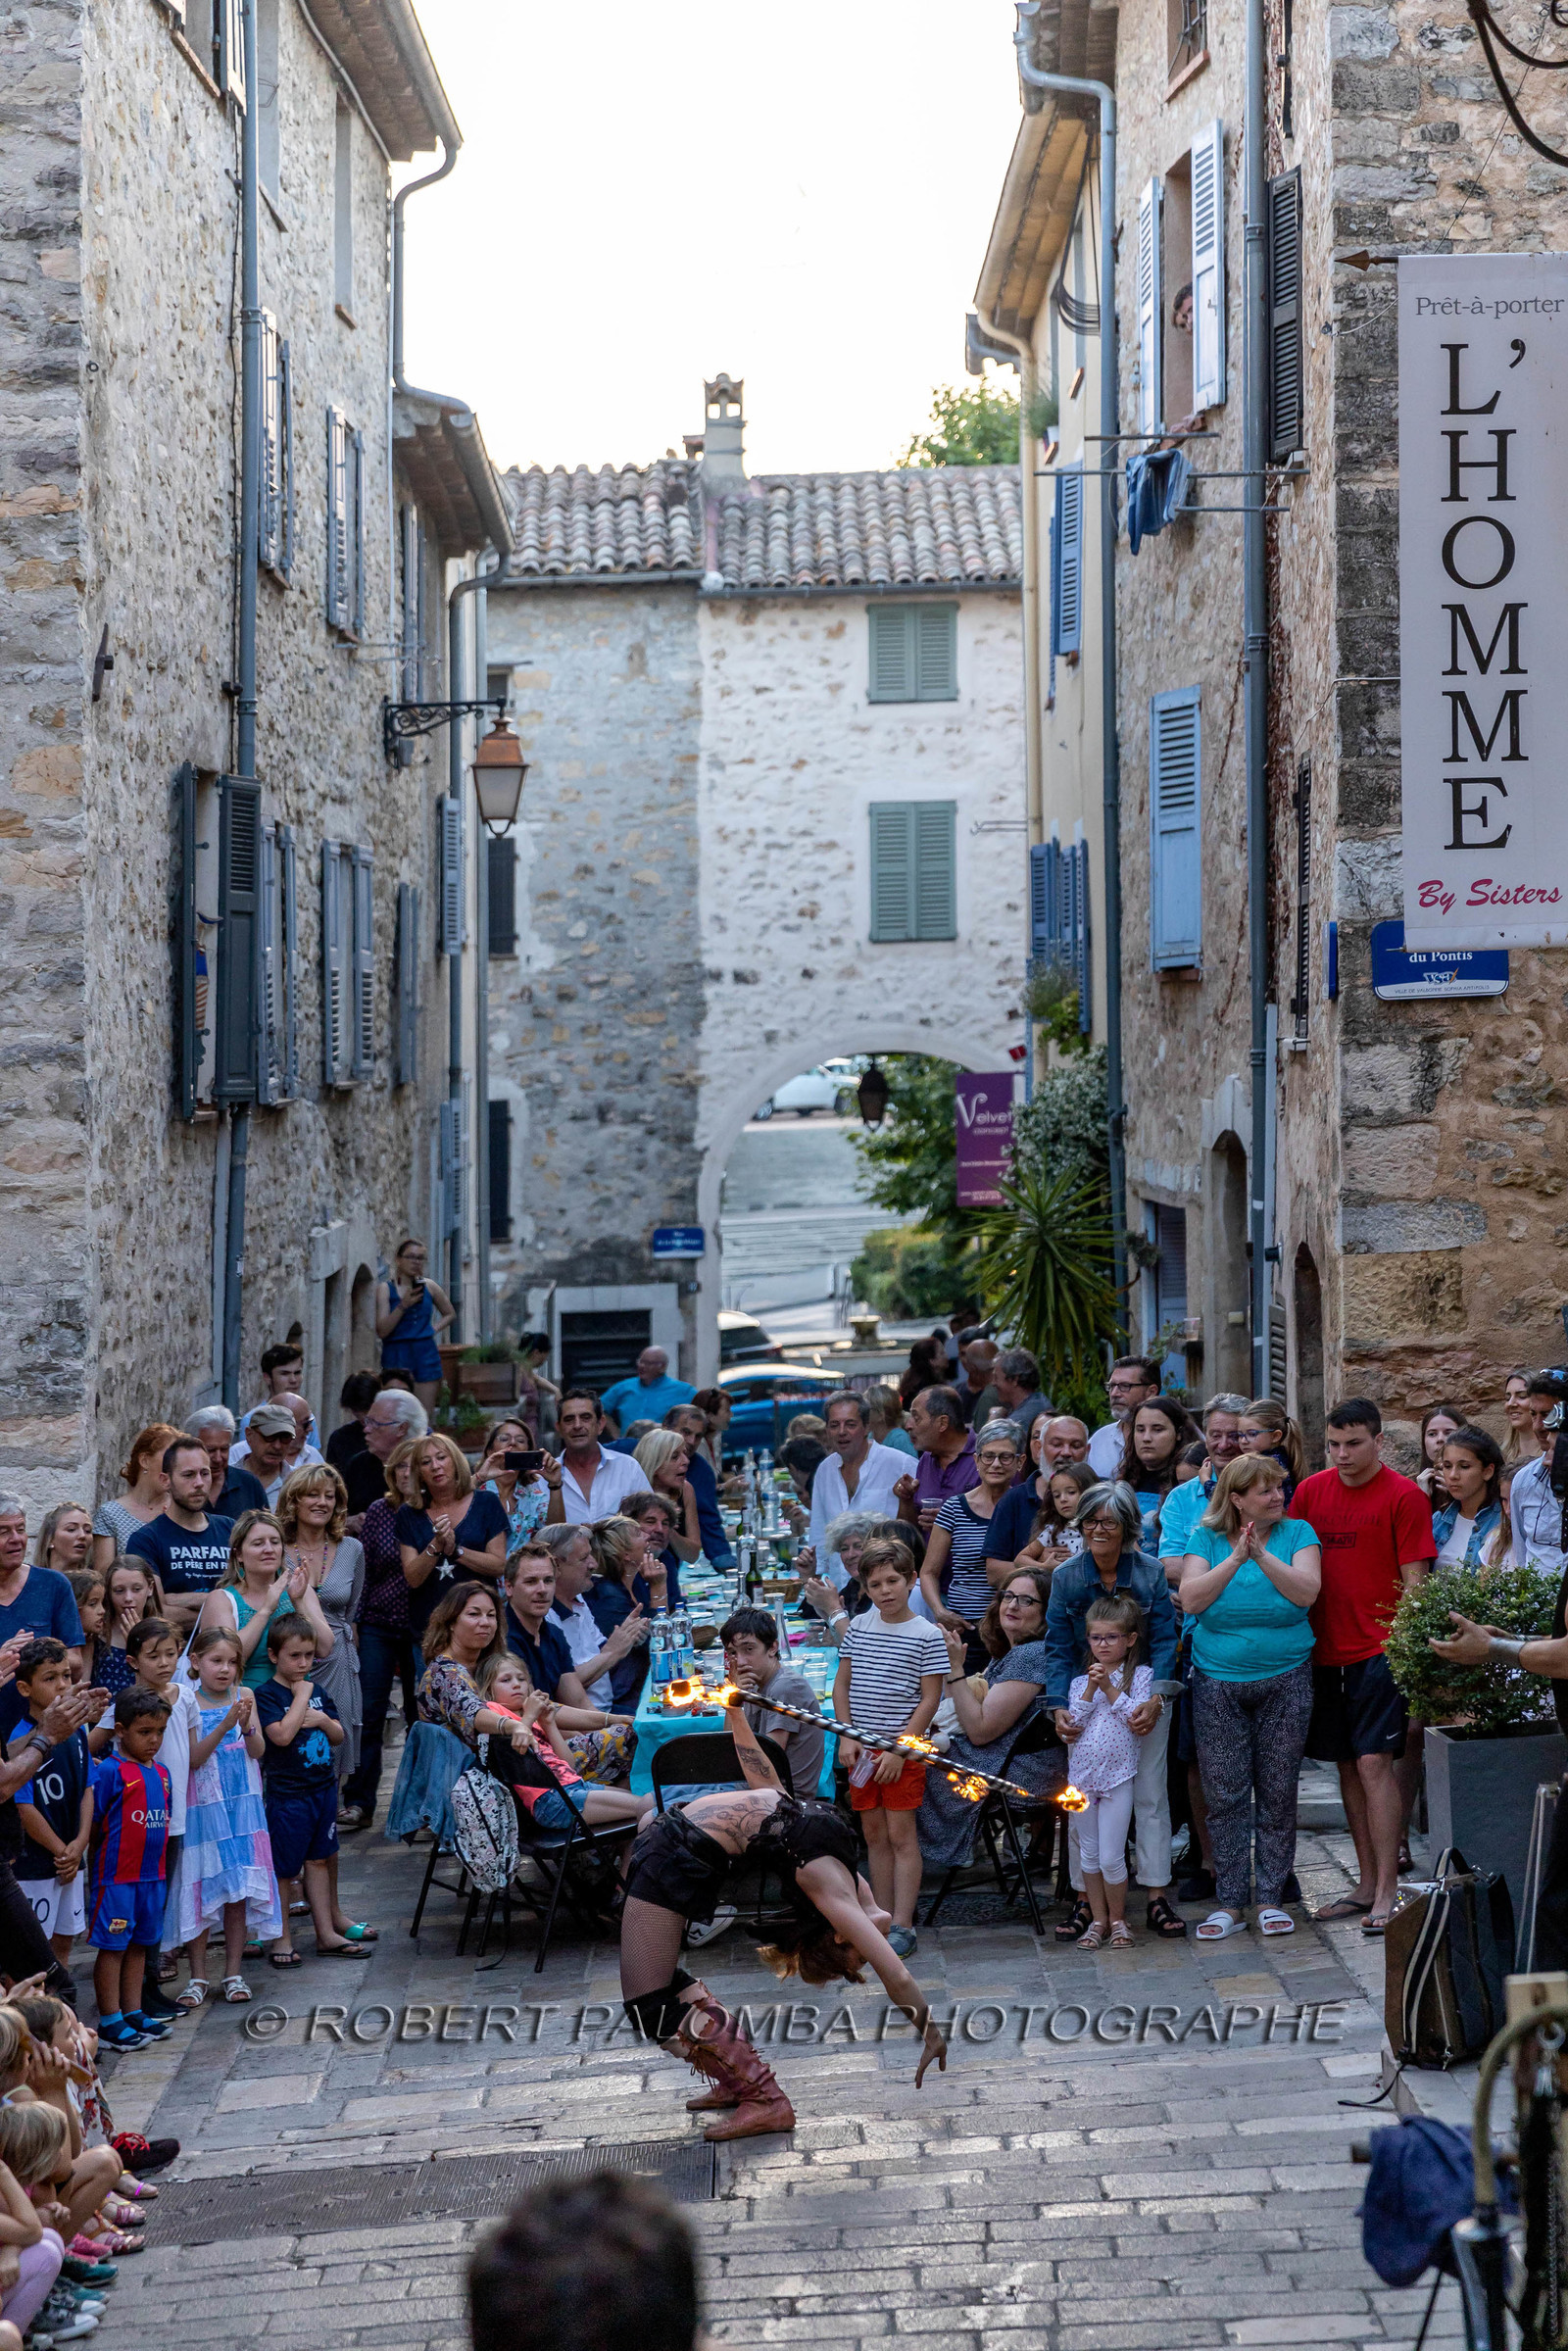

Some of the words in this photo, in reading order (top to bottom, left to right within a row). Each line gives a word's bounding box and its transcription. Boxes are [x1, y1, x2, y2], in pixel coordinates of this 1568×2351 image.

[1415, 295, 1565, 318] Prêt-à-porter
[1417, 879, 1457, 915] By
[1465, 878, 1564, 906] Sisters
[1408, 952, 1427, 963] du
[1431, 951, 1473, 962] Pontis
[170, 1546, 232, 1560] PARFAIT
[171, 1561, 183, 1570] DE
[184, 1559, 204, 1570] PÈRE
[205, 1561, 219, 1570] EN
[36, 1773, 66, 1806] 10
[27, 1897, 50, 1924] 0
